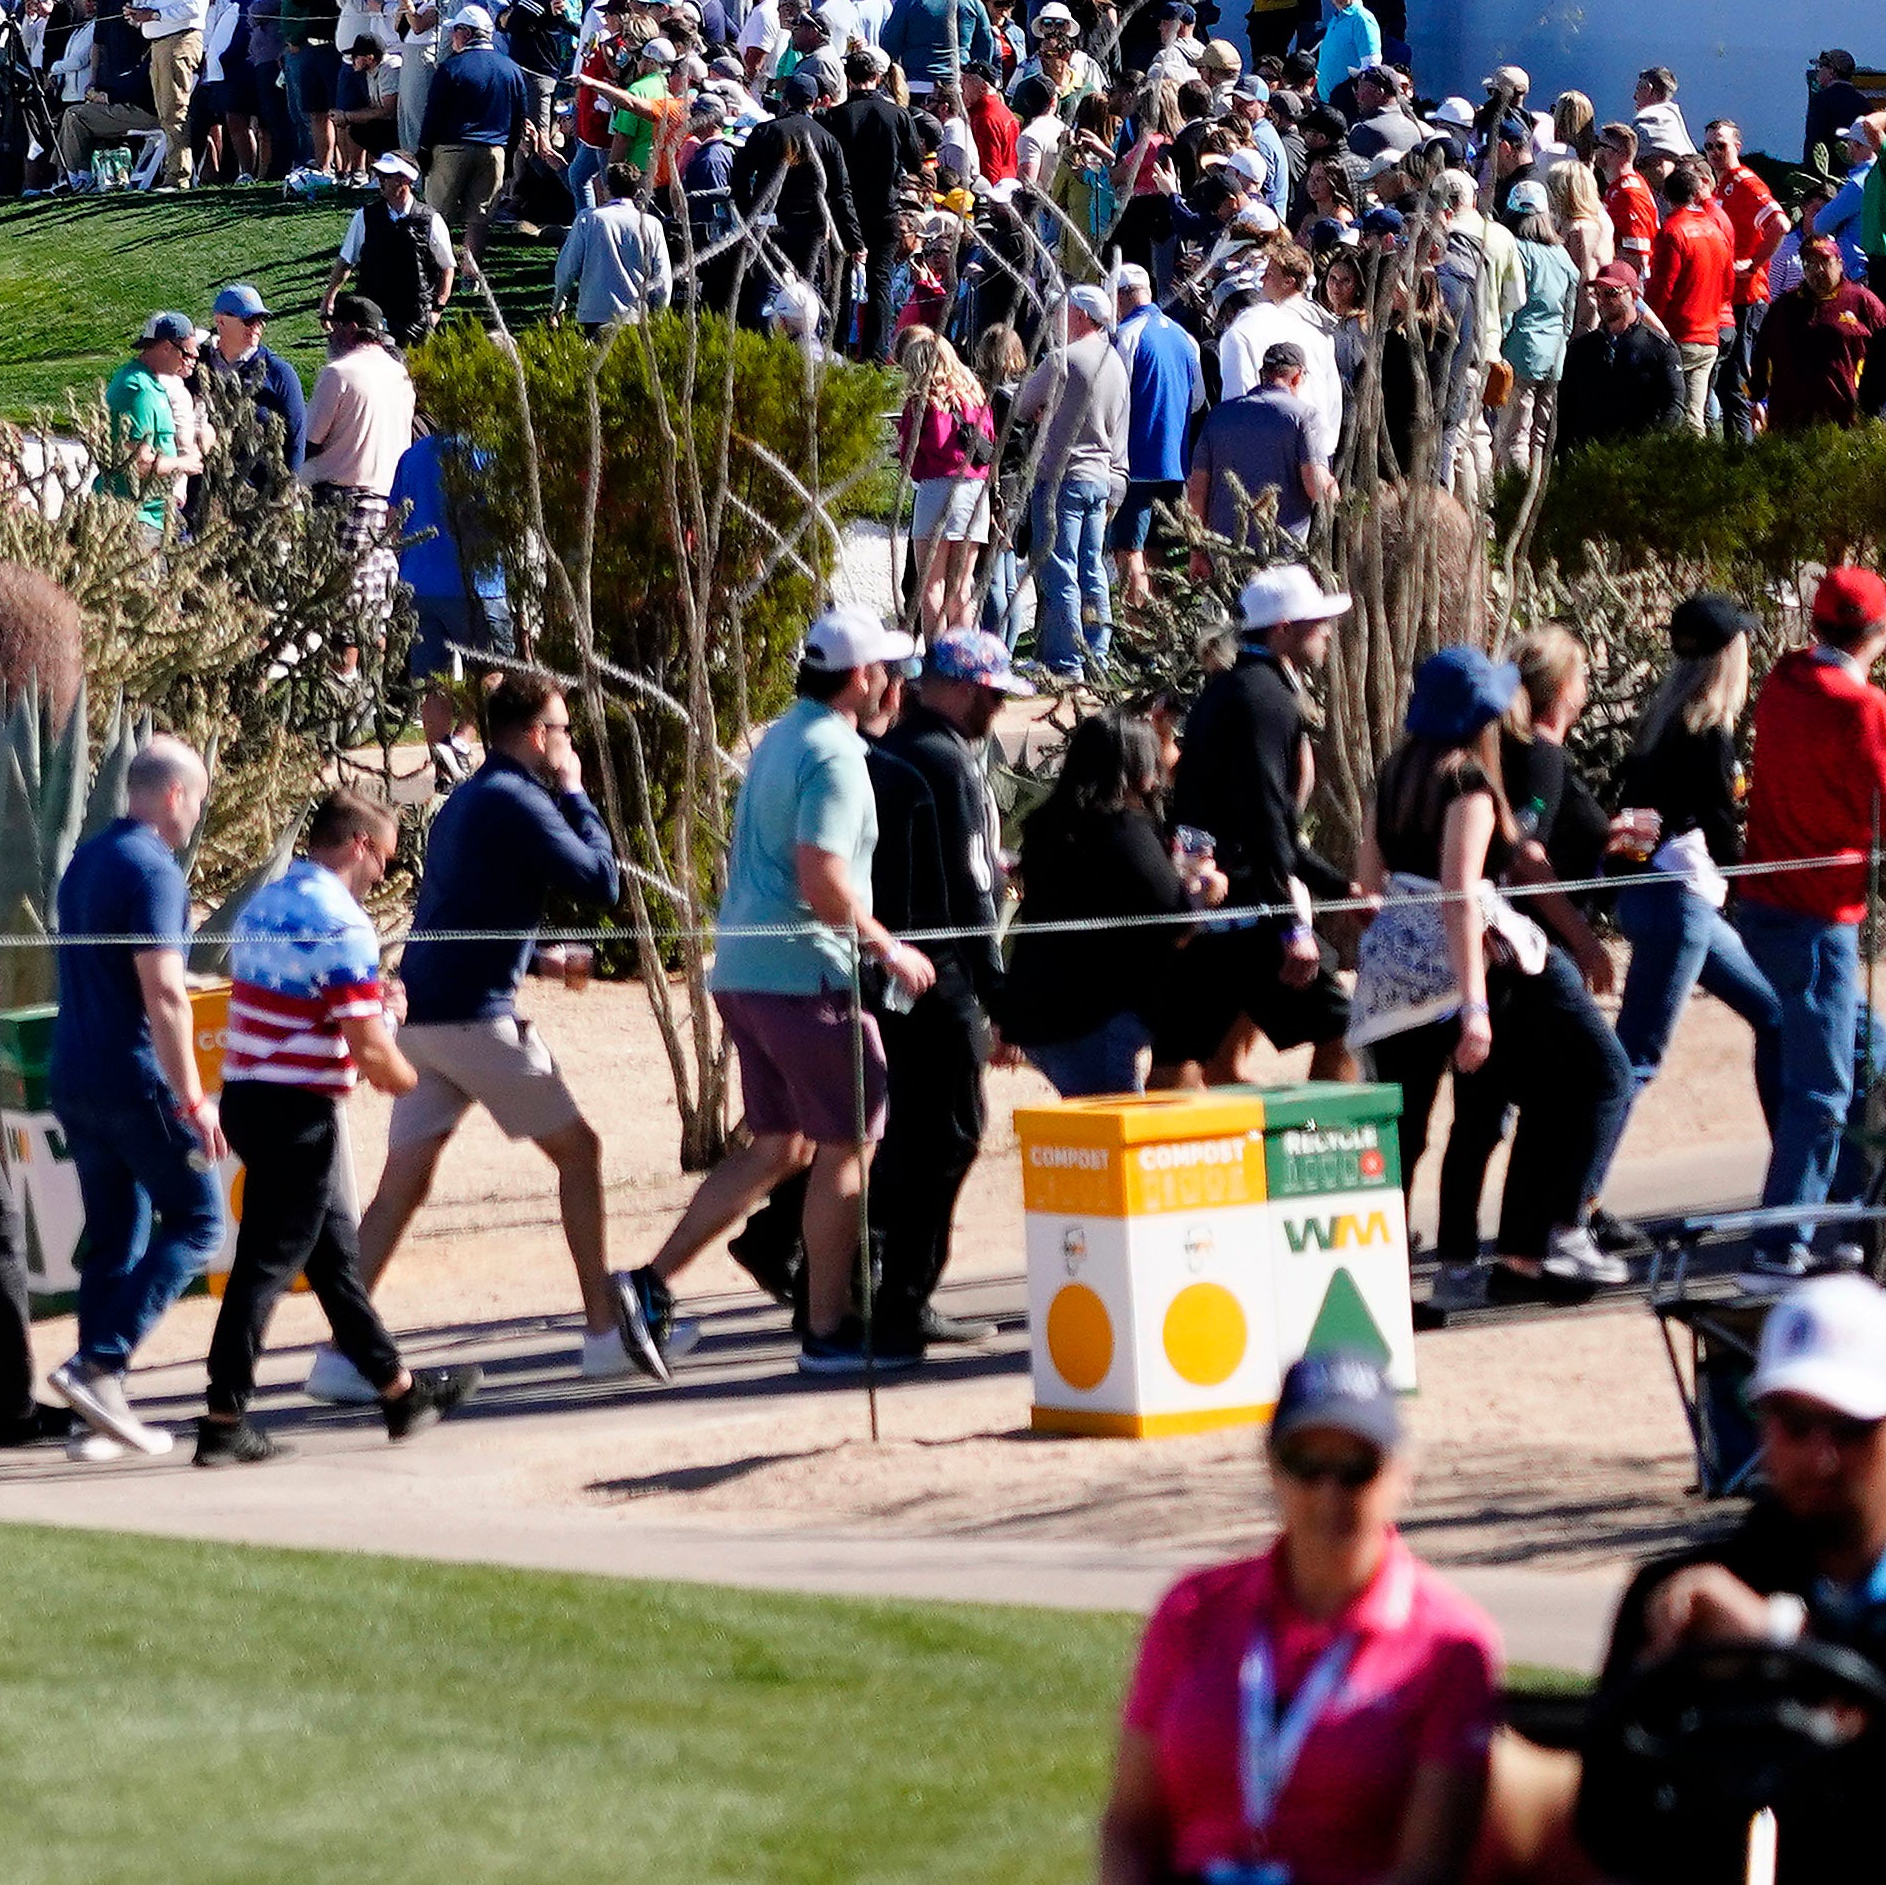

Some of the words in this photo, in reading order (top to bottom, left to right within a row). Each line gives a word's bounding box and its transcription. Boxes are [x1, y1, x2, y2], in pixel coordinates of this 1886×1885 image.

[1030, 1145, 1109, 1171] COMPOST
[1138, 1137, 1245, 1171] COMPOST
[1284, 1210, 1391, 1254] WM
